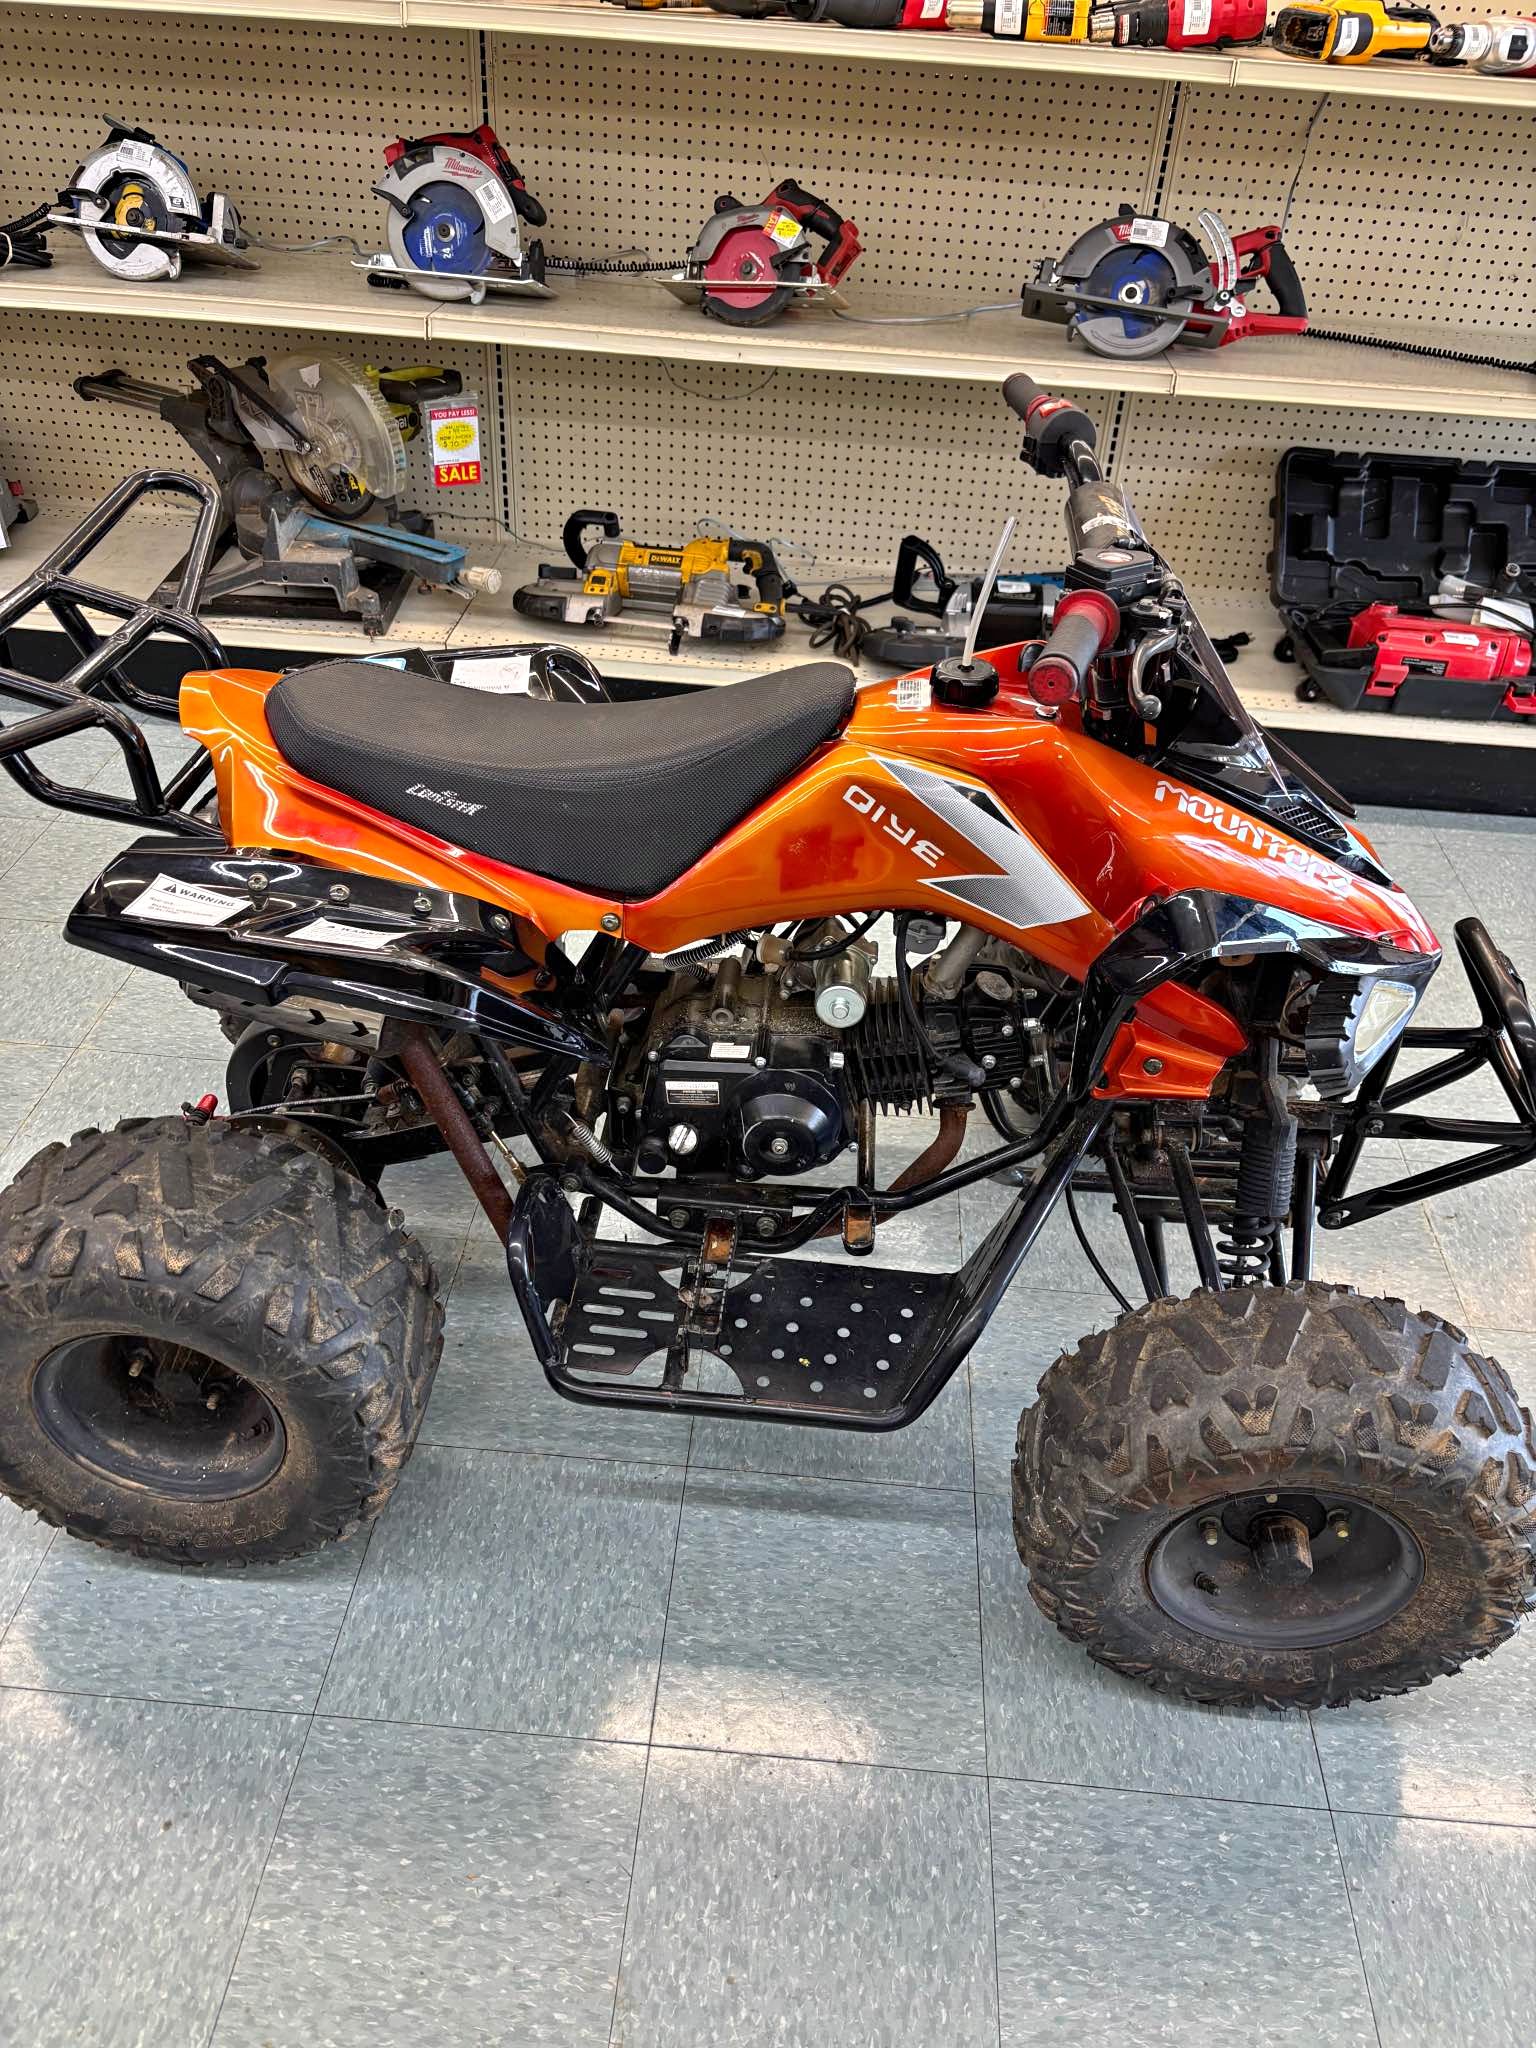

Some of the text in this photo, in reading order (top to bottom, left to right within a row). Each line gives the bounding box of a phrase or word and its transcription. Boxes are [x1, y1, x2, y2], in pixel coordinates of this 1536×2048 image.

[444, 157, 483, 175] Milwaukee
[434, 411, 448, 419] YOU
[440, 466, 477, 482] SALE
[842, 784, 945, 868] QIYE
[179, 887, 236, 908] WARNING
